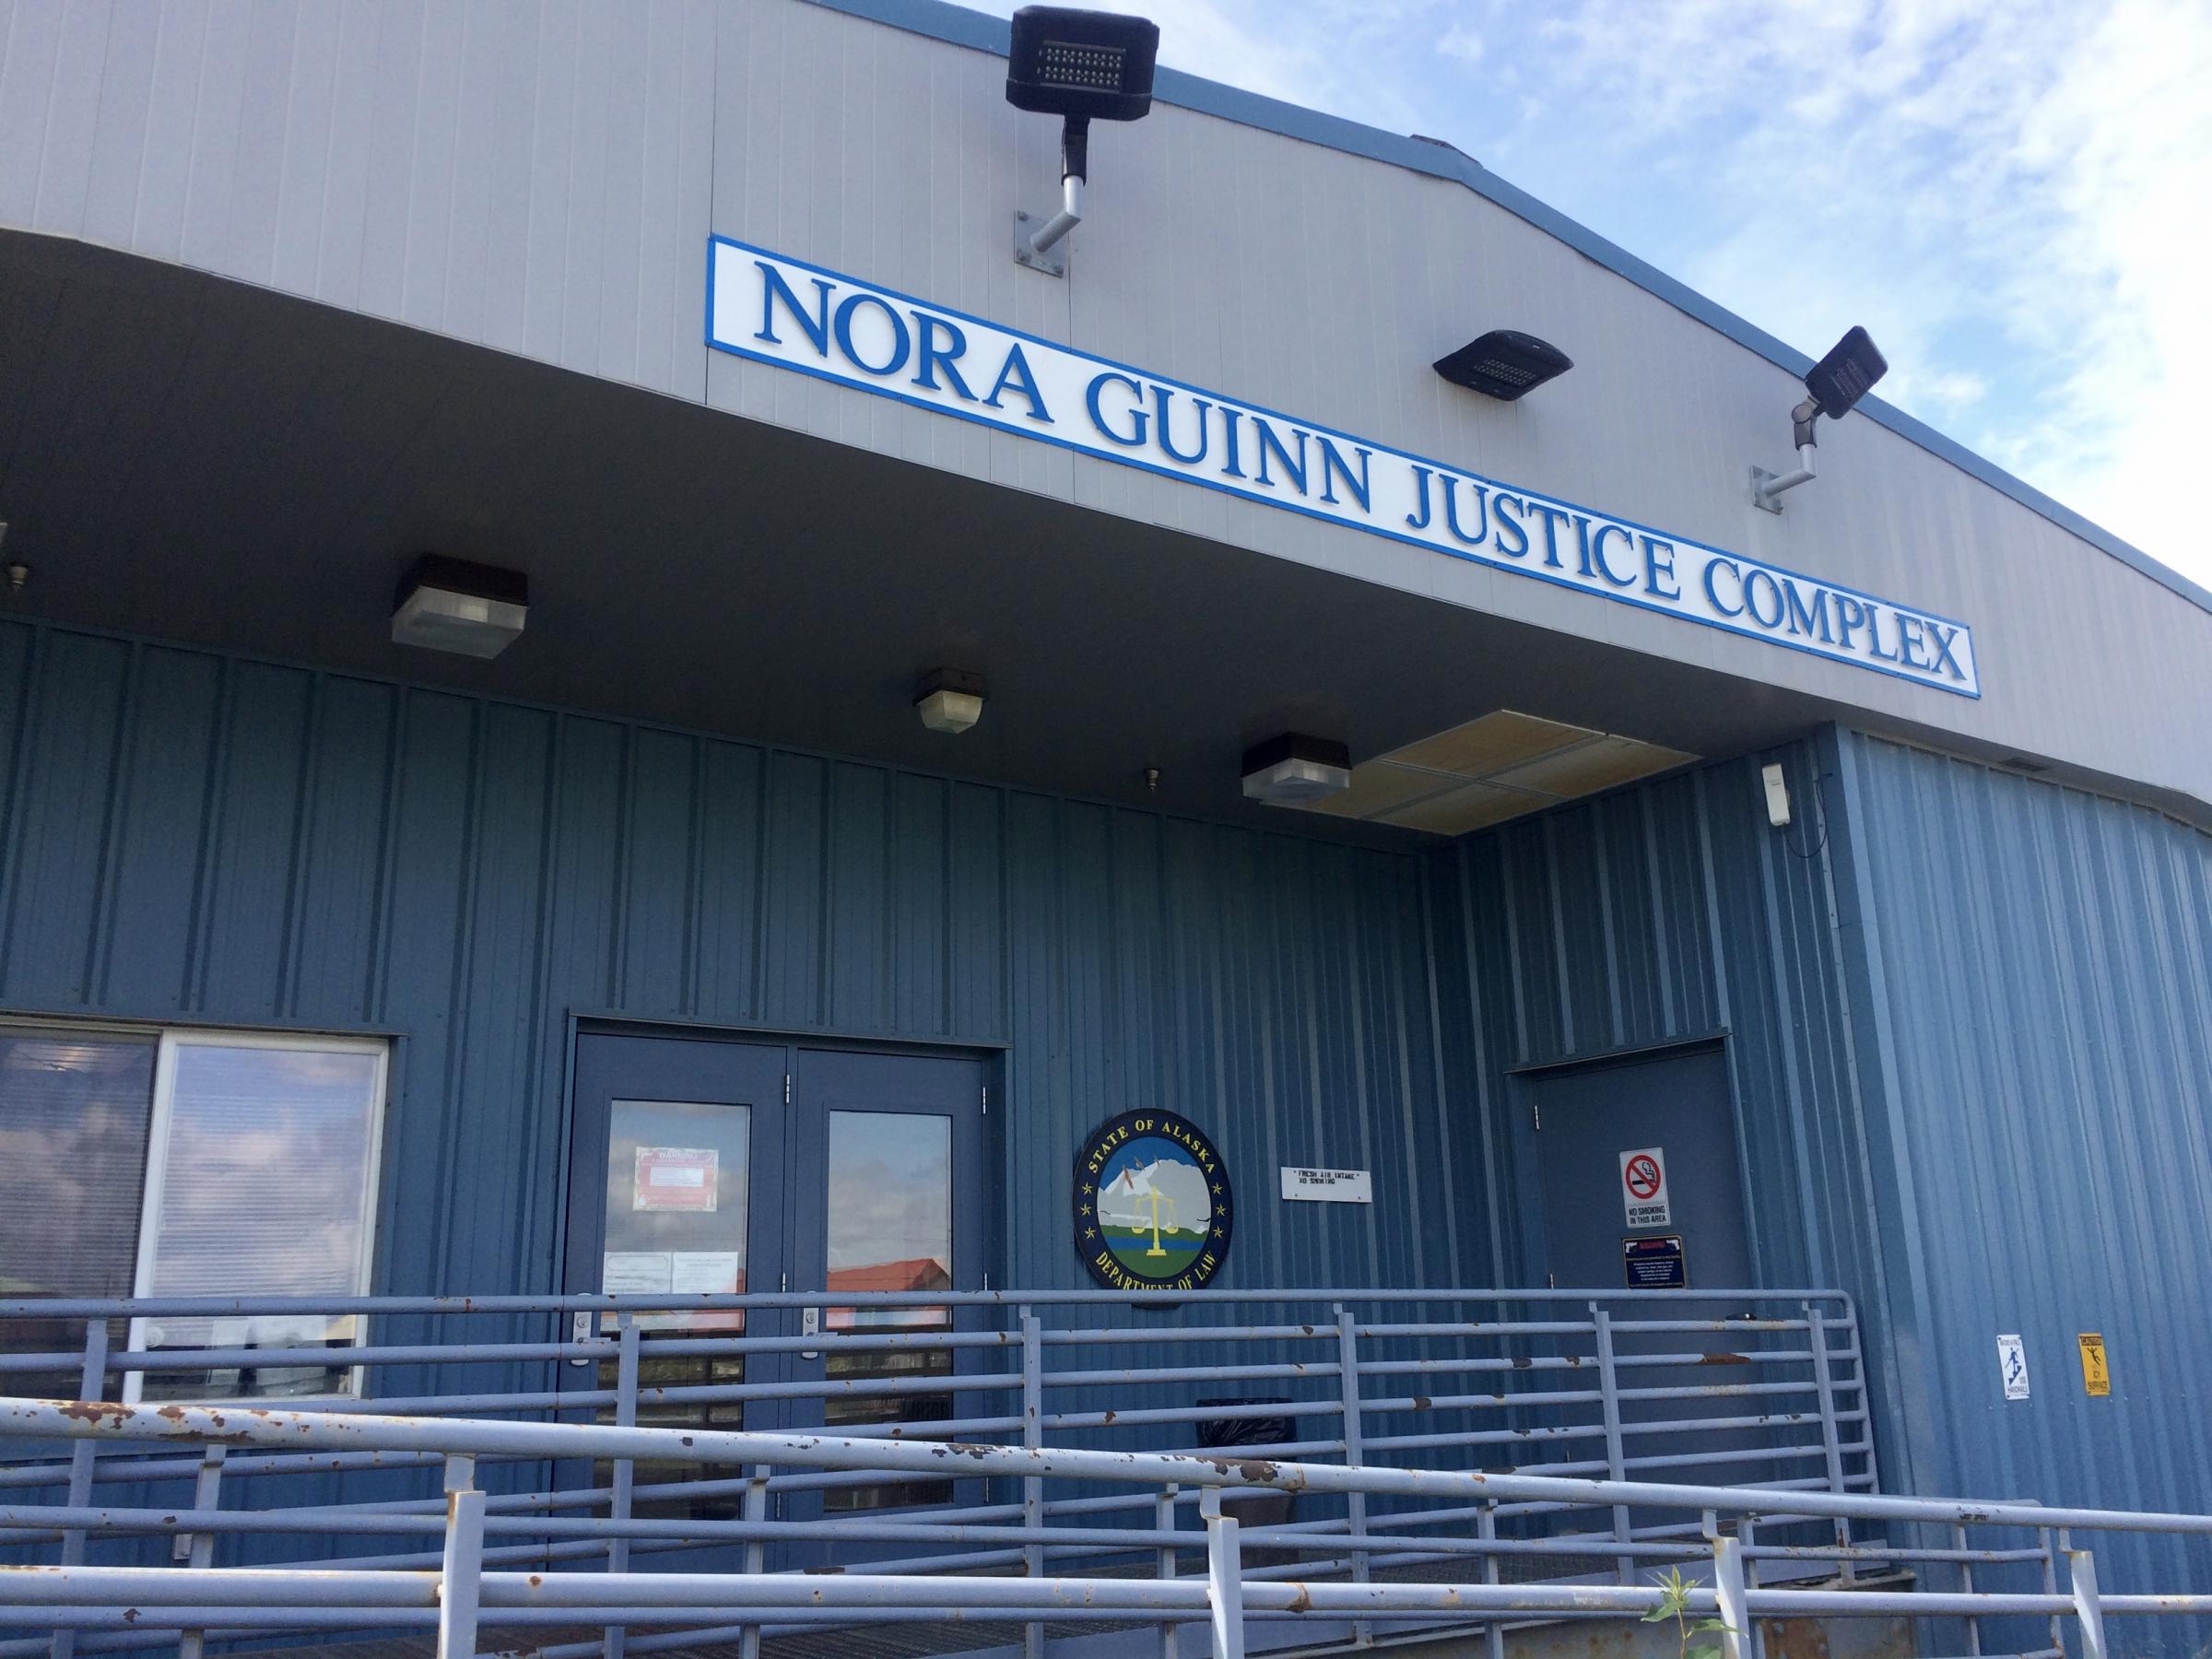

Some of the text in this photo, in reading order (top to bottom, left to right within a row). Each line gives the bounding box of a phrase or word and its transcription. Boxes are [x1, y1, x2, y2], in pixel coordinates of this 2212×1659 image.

[753, 259, 1968, 681] NORA GUINN JUSTICE COMPLEX
[1088, 1119, 1216, 1174] STATE OF ALASKA
[1298, 1170, 1318, 1178] FRESH
[1334, 1172, 1356, 1181] INTAKE
[1629, 1206, 1665, 1216] NO SMOKING
[1630, 1217, 1636, 1225] IN
[1637, 1216, 1651, 1224] THIS
[1178, 1274, 1193, 1290] OF
[1194, 1251, 1216, 1281] LAW
